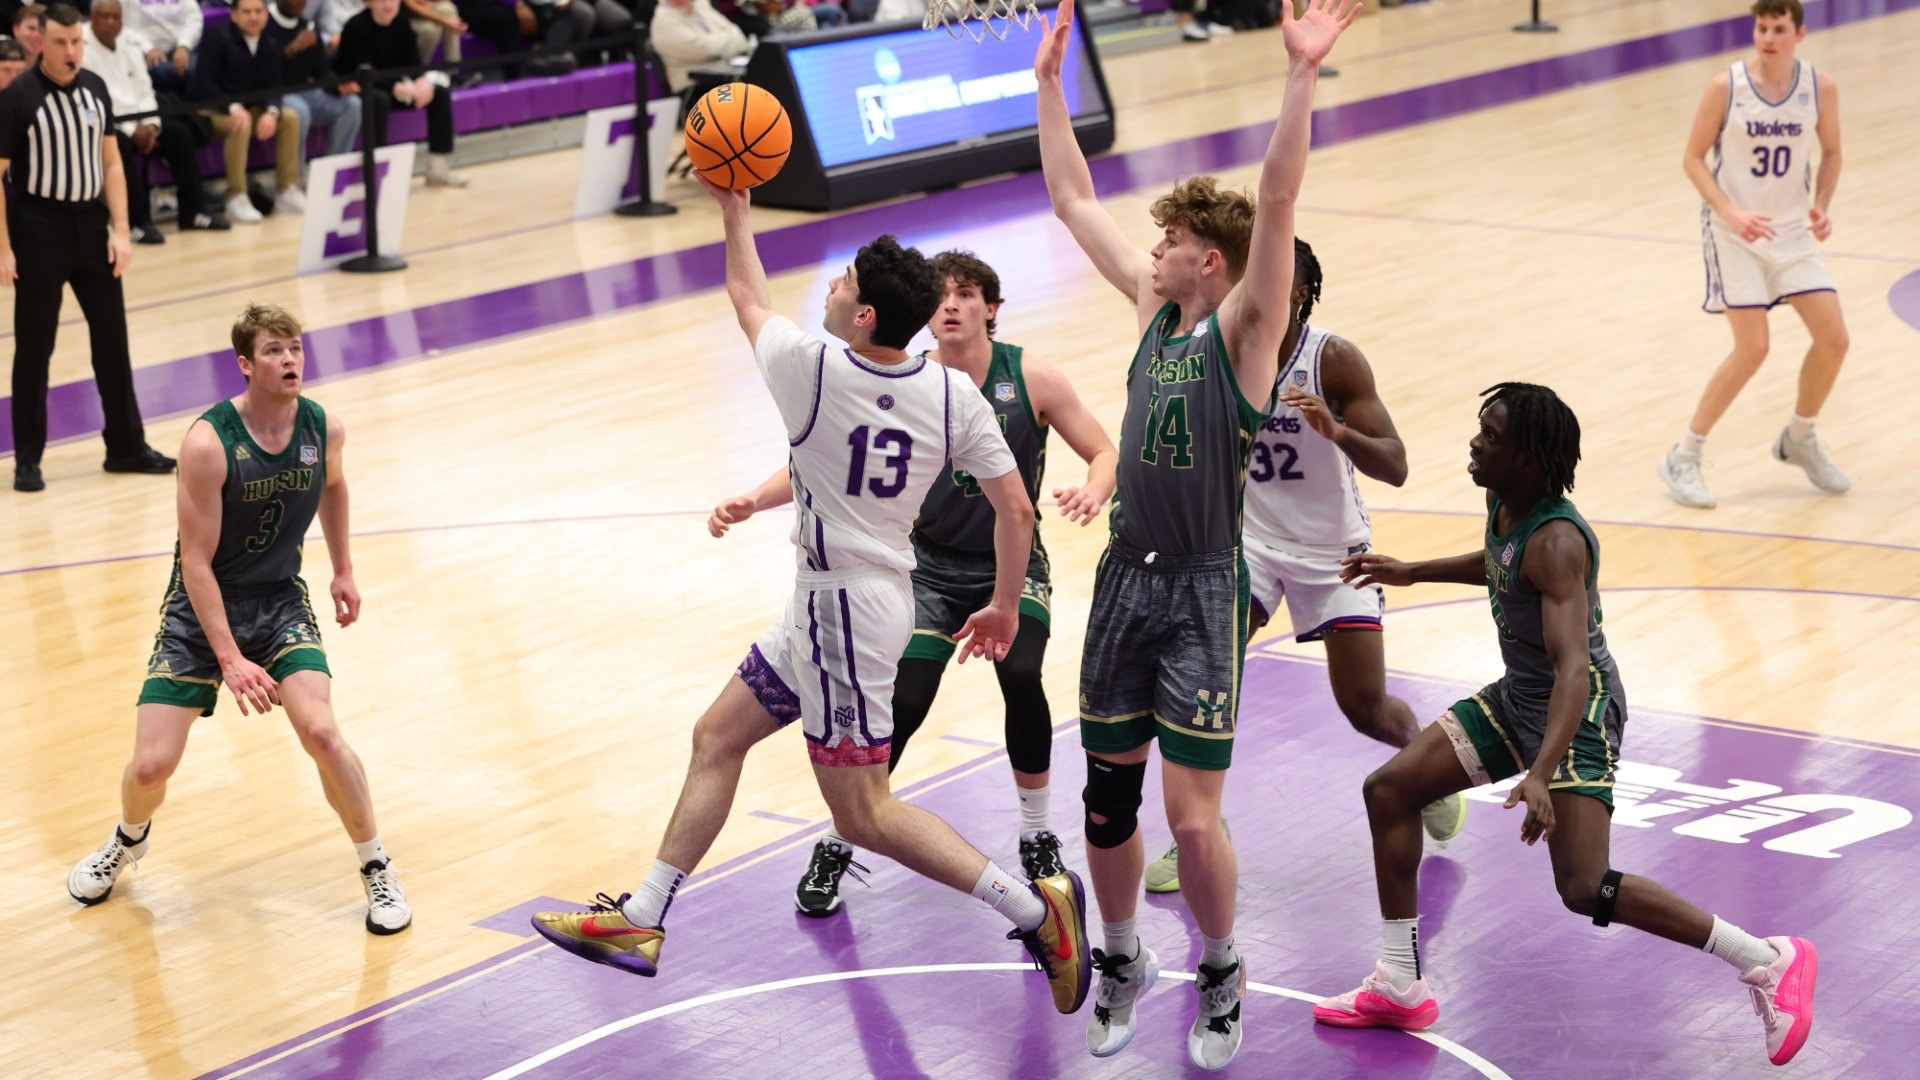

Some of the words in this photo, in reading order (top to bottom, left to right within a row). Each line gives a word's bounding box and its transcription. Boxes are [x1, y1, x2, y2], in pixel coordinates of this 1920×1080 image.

[1746, 119, 1803, 138] Violets
[1750, 145, 1792, 178] 30
[1140, 391, 1194, 470] 14
[845, 425, 914, 498] 13
[1250, 441, 1305, 483] 32
[245, 499, 285, 553] 3
